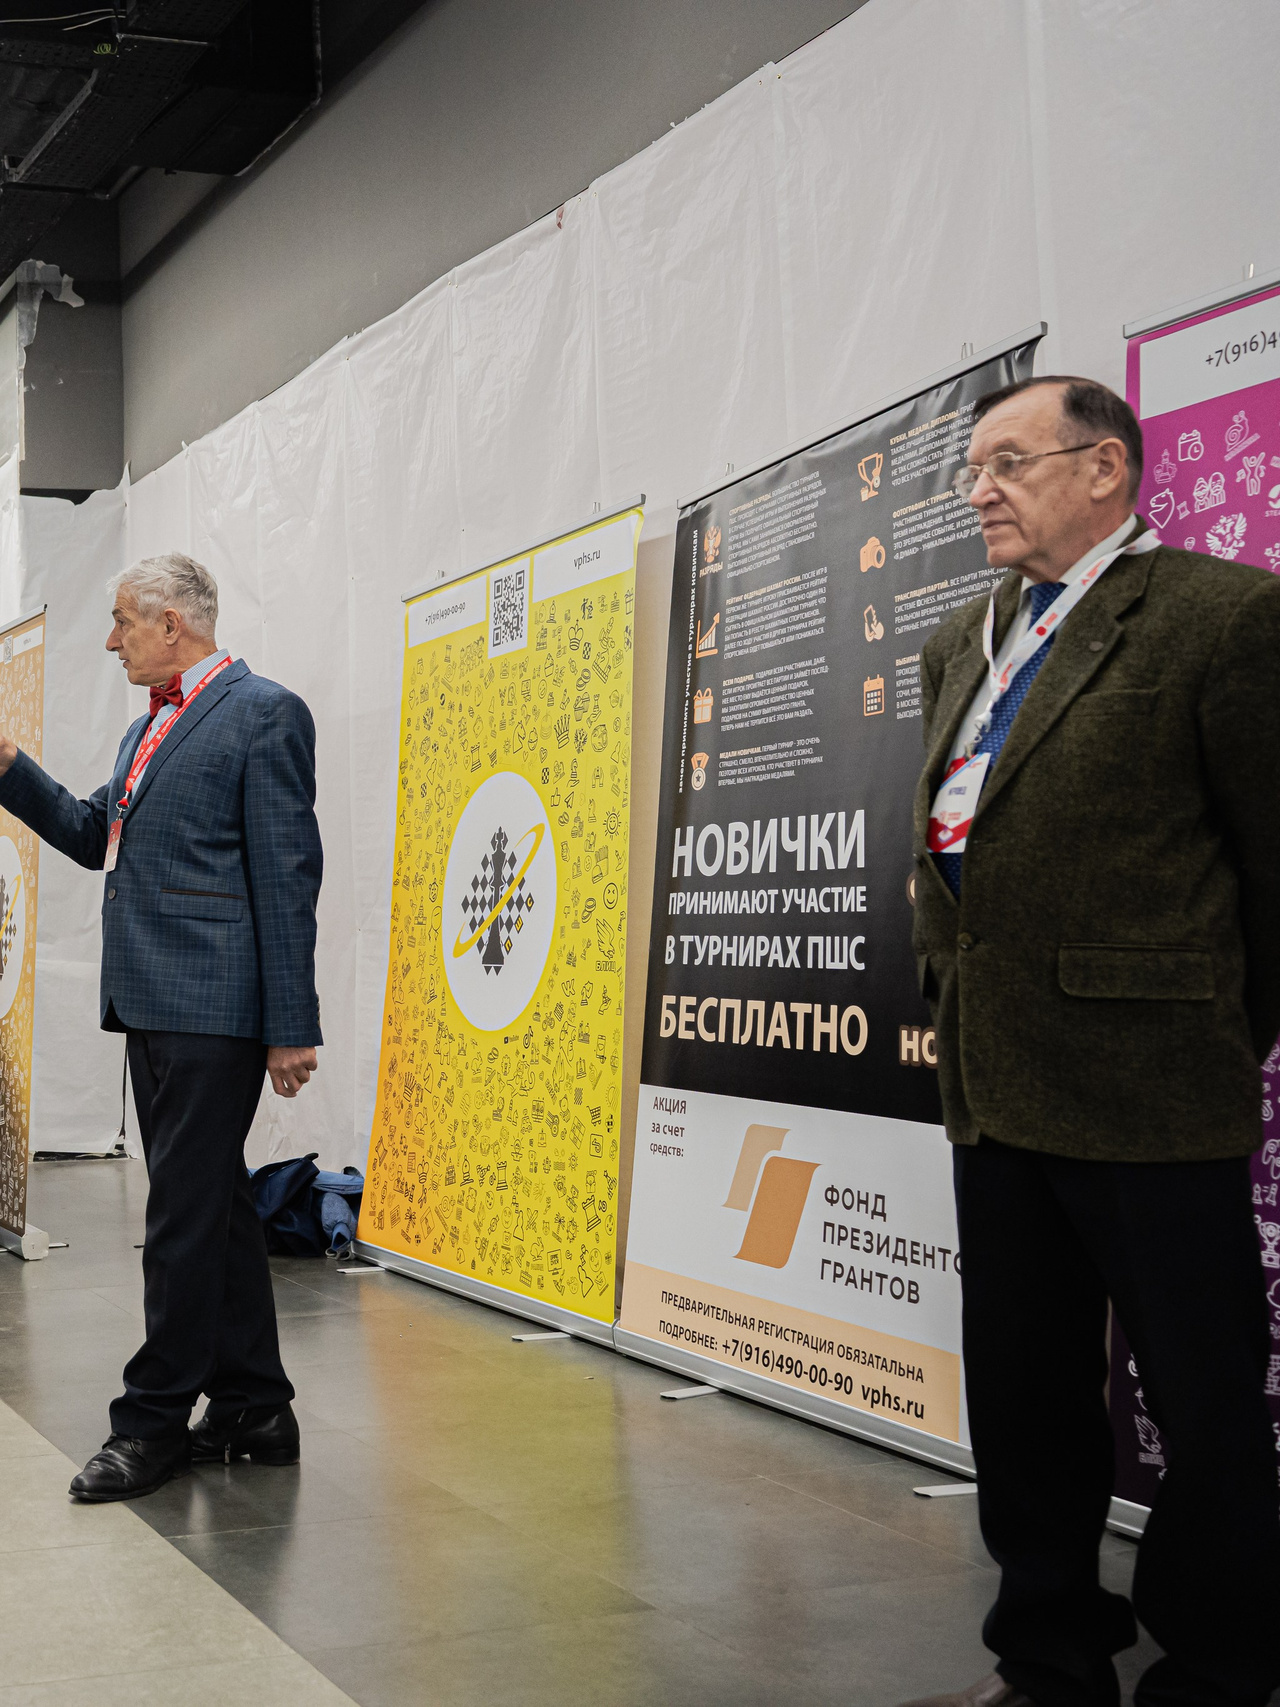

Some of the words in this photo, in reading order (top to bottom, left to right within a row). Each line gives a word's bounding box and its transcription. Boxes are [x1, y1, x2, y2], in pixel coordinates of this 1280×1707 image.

[1205, 331, 1280, 367] +7(916)4
[574, 550, 601, 570] vphs.ru
[699, 562, 723, 578] РАЗРЯДЫ
[672, 809, 865, 877] НОВИЧКИ
[669, 889, 778, 915] ПРИНИМАЮТ
[782, 886, 867, 913] УЧАСТИЕ
[595, 961, 616, 973] БЛИЦ
[665, 935, 675, 964] В
[680, 935, 801, 969] ТУРНИРАХ
[807, 936, 866, 970] ПШС
[660, 994, 868, 1056] БЕСПЛАТНО
[653, 1096, 687, 1115] АКЦИЯ
[651, 1122, 661, 1134] за
[662, 1124, 685, 1138] счет
[649, 1142, 684, 1157] средств:
[824, 1184, 887, 1222] ФОНД
[822, 1221, 962, 1277] ПРЕЗИДЕНТО
[820, 1258, 921, 1304] ГРАНТОВ
[661, 1291, 755, 1331] ПРЕДВАРИТЕЛЬНАЯ
[758, 1320, 834, 1355] РЕГИСТРАЦИЯ
[837, 1343, 924, 1383] ОБЯЗАТАЛЬНА
[659, 1320, 718, 1351] ПОДРОБНЕЕ:
[722, 1338, 853, 1395] +7(916)490-00-90
[861, 1384, 924, 1419] vphs.ru
